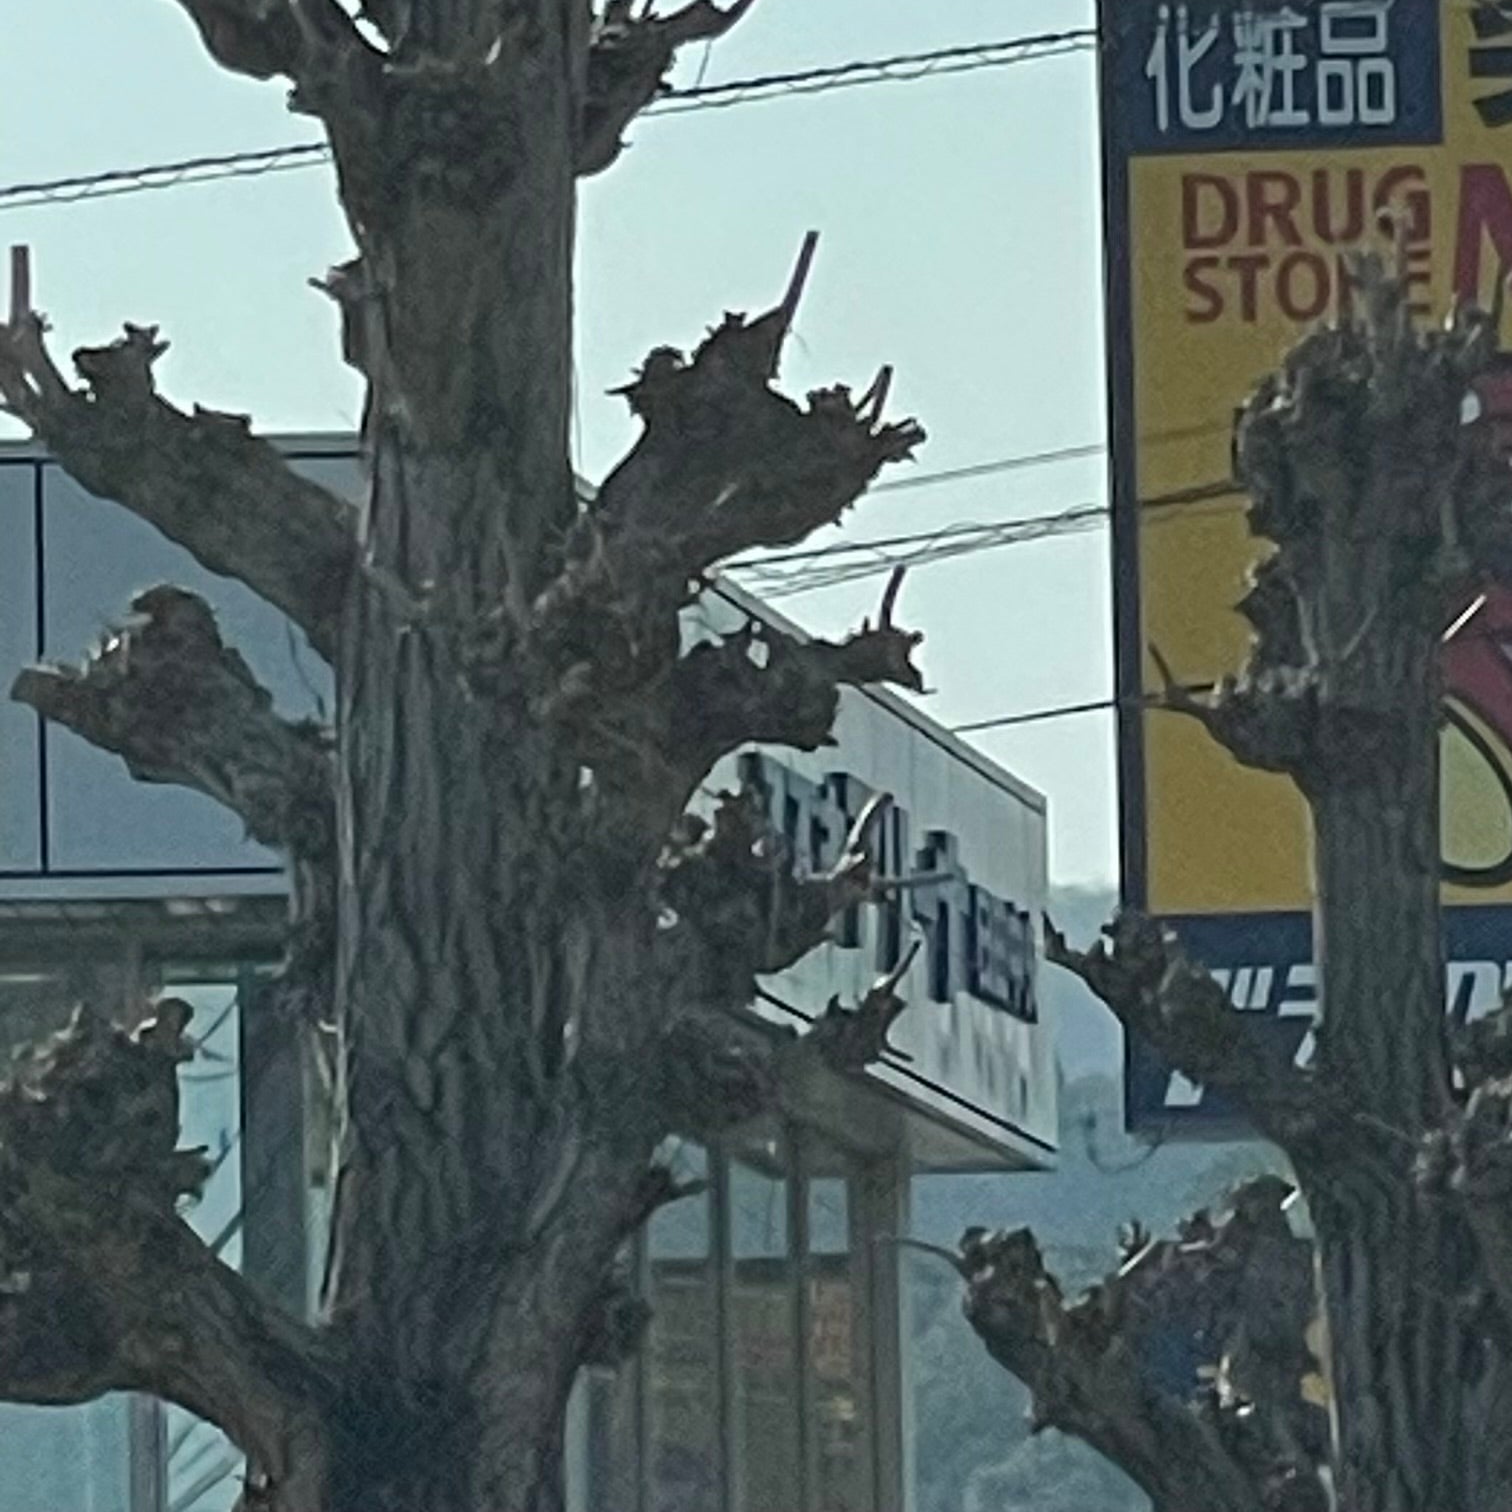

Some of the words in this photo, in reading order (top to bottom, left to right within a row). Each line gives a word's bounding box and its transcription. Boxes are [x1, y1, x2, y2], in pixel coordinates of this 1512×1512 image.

[1146, 0, 1395, 132] 化粧品
[1181, 164, 1432, 250] DRUG
